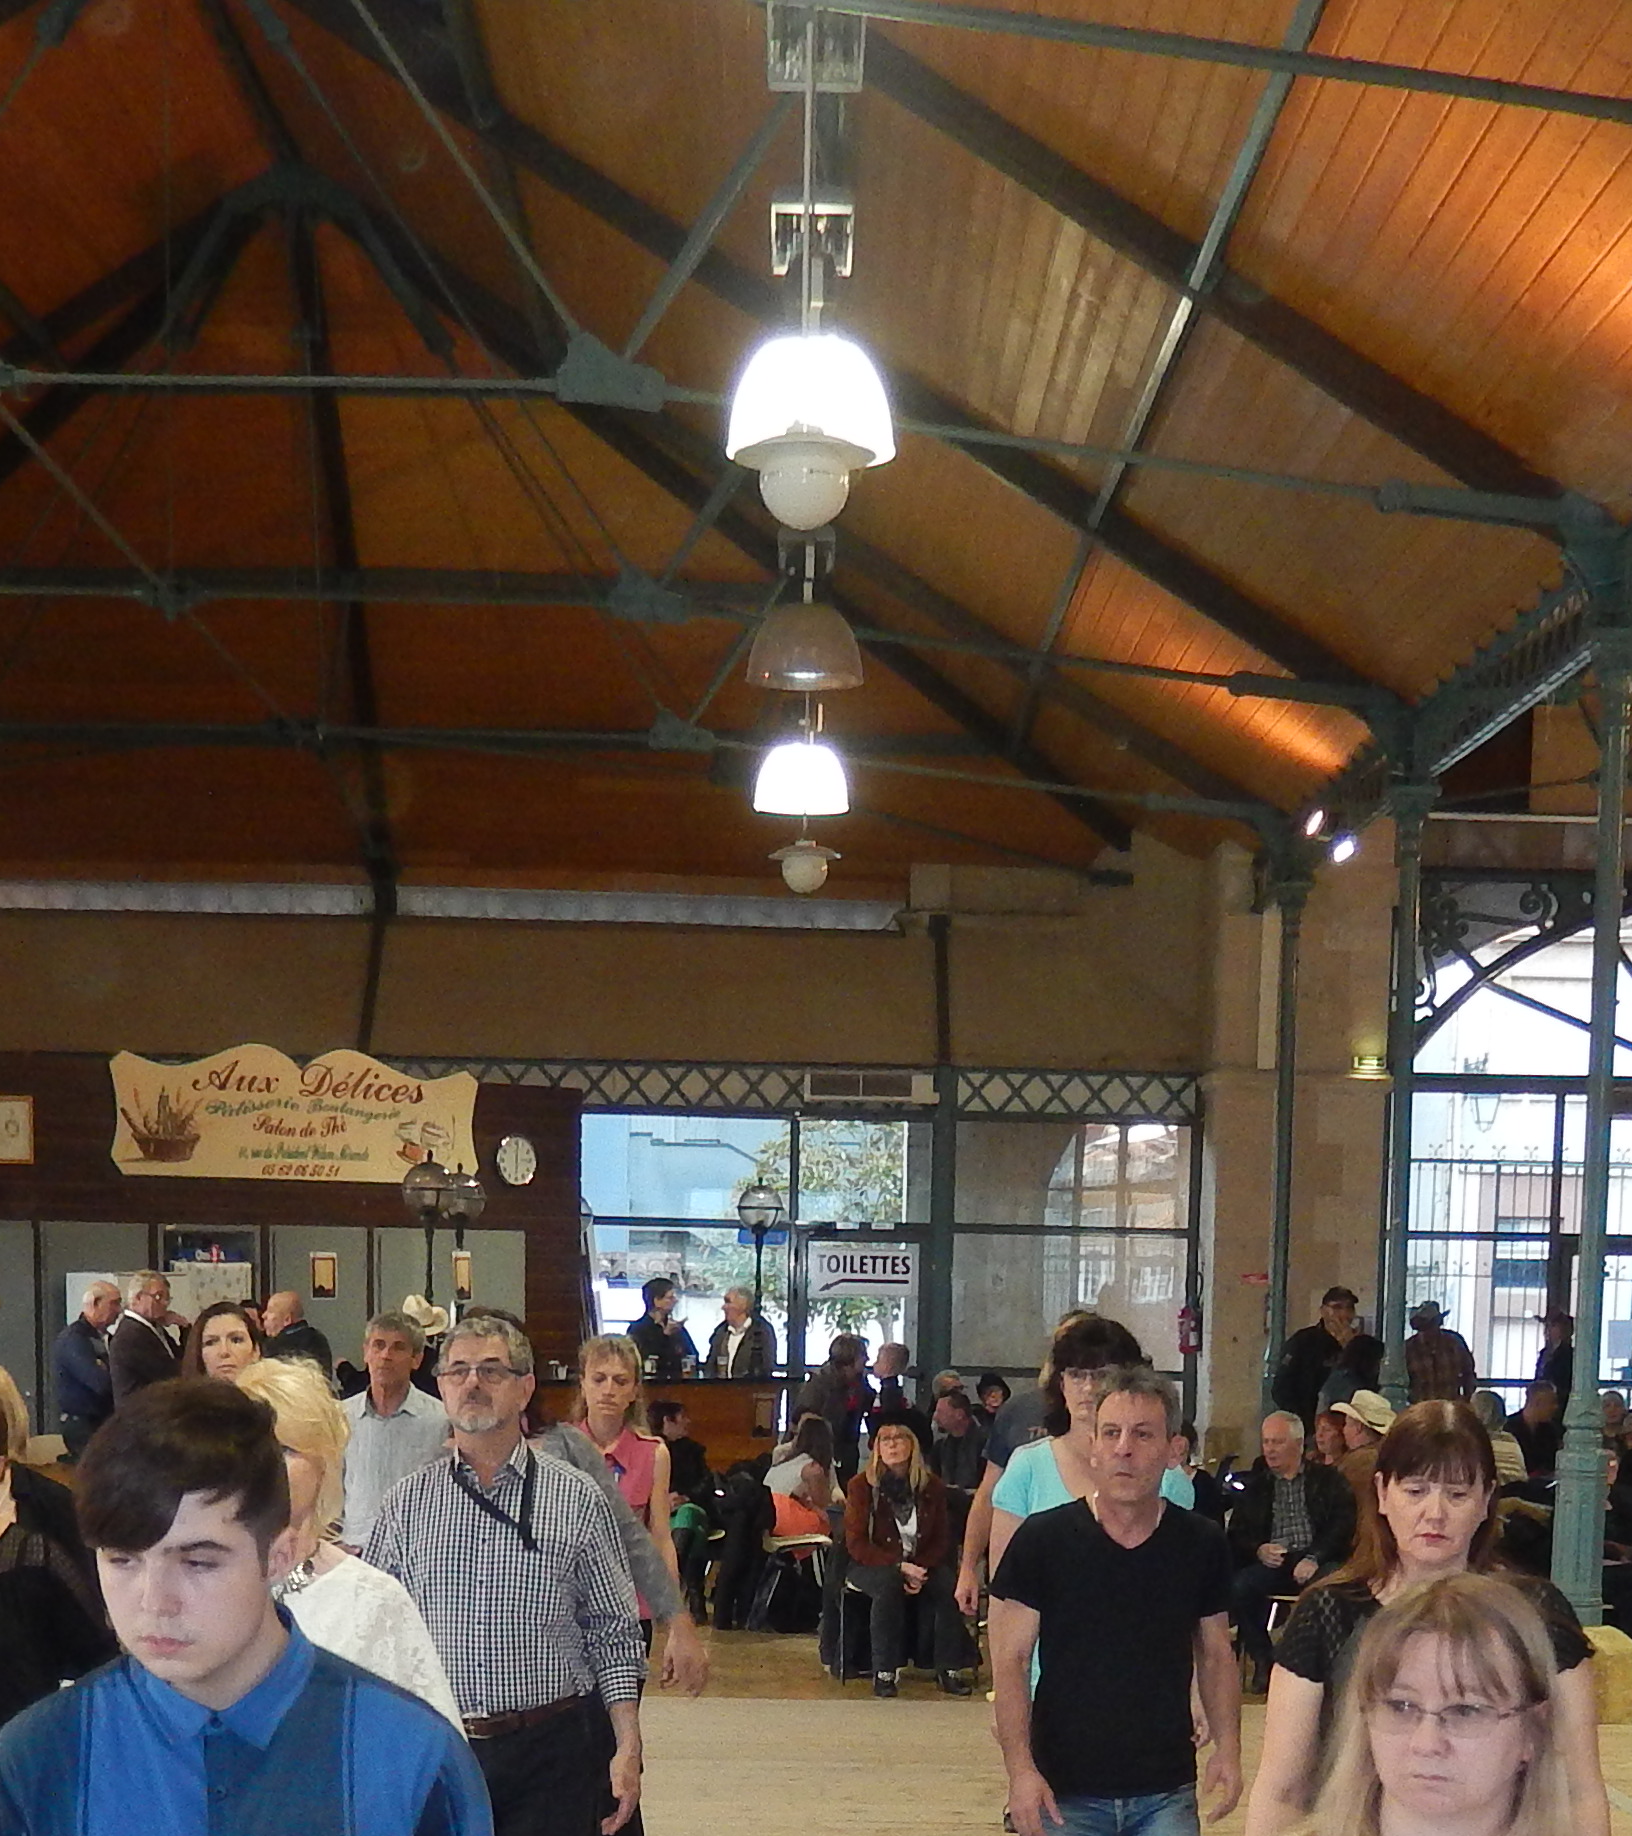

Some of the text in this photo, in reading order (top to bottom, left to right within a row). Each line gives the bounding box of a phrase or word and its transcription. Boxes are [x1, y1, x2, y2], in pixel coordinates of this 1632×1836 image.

[192, 1060, 423, 1104] Aux Délices
[252, 1113, 296, 1137] Salon
[817, 1254, 911, 1275] TOILETTES
